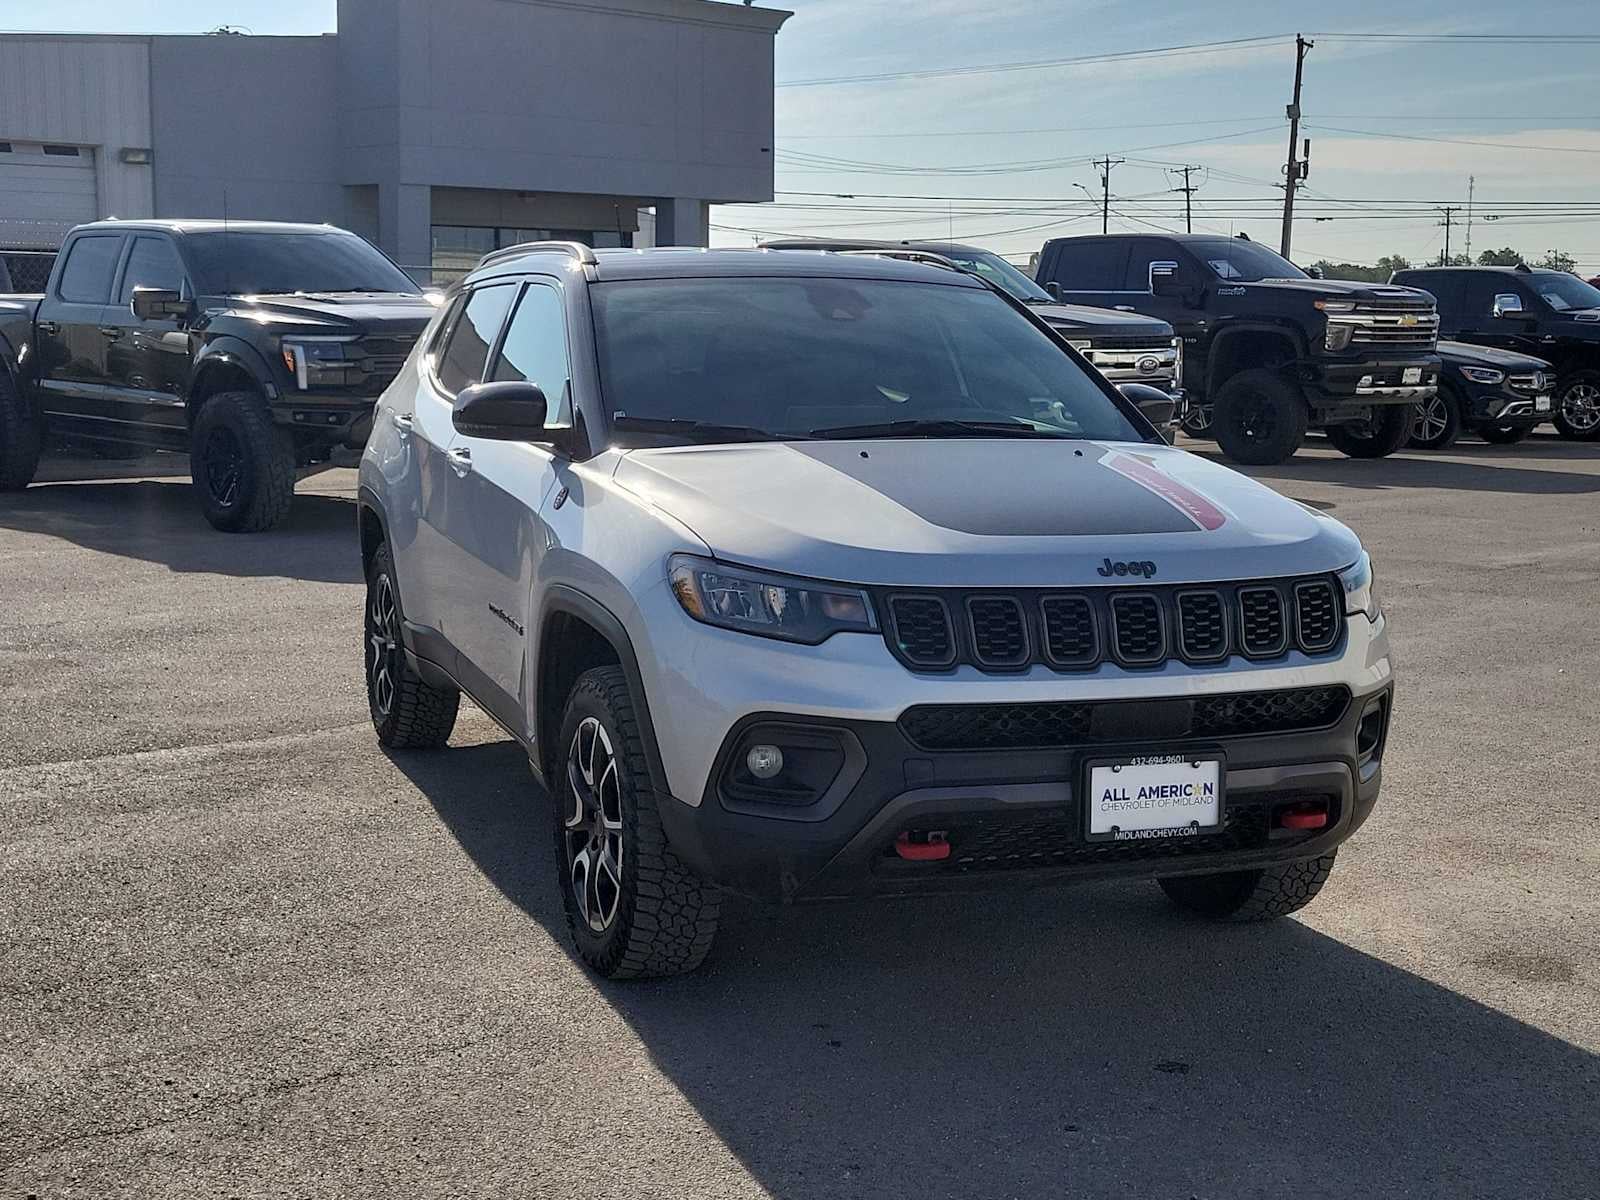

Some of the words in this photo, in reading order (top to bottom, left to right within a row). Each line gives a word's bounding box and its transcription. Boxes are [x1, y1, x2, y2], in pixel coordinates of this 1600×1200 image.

[1096, 558, 1157, 579] Jeep
[1130, 755, 1185, 766] 432-694-9601
[1102, 788, 1131, 802] ALL
[1101, 800, 1155, 812] CHEVROLET
[1158, 798, 1170, 808] OF
[1173, 796, 1214, 807] MIDLAND
[1114, 827, 1198, 840] MIDLANDCHEVY.COM
